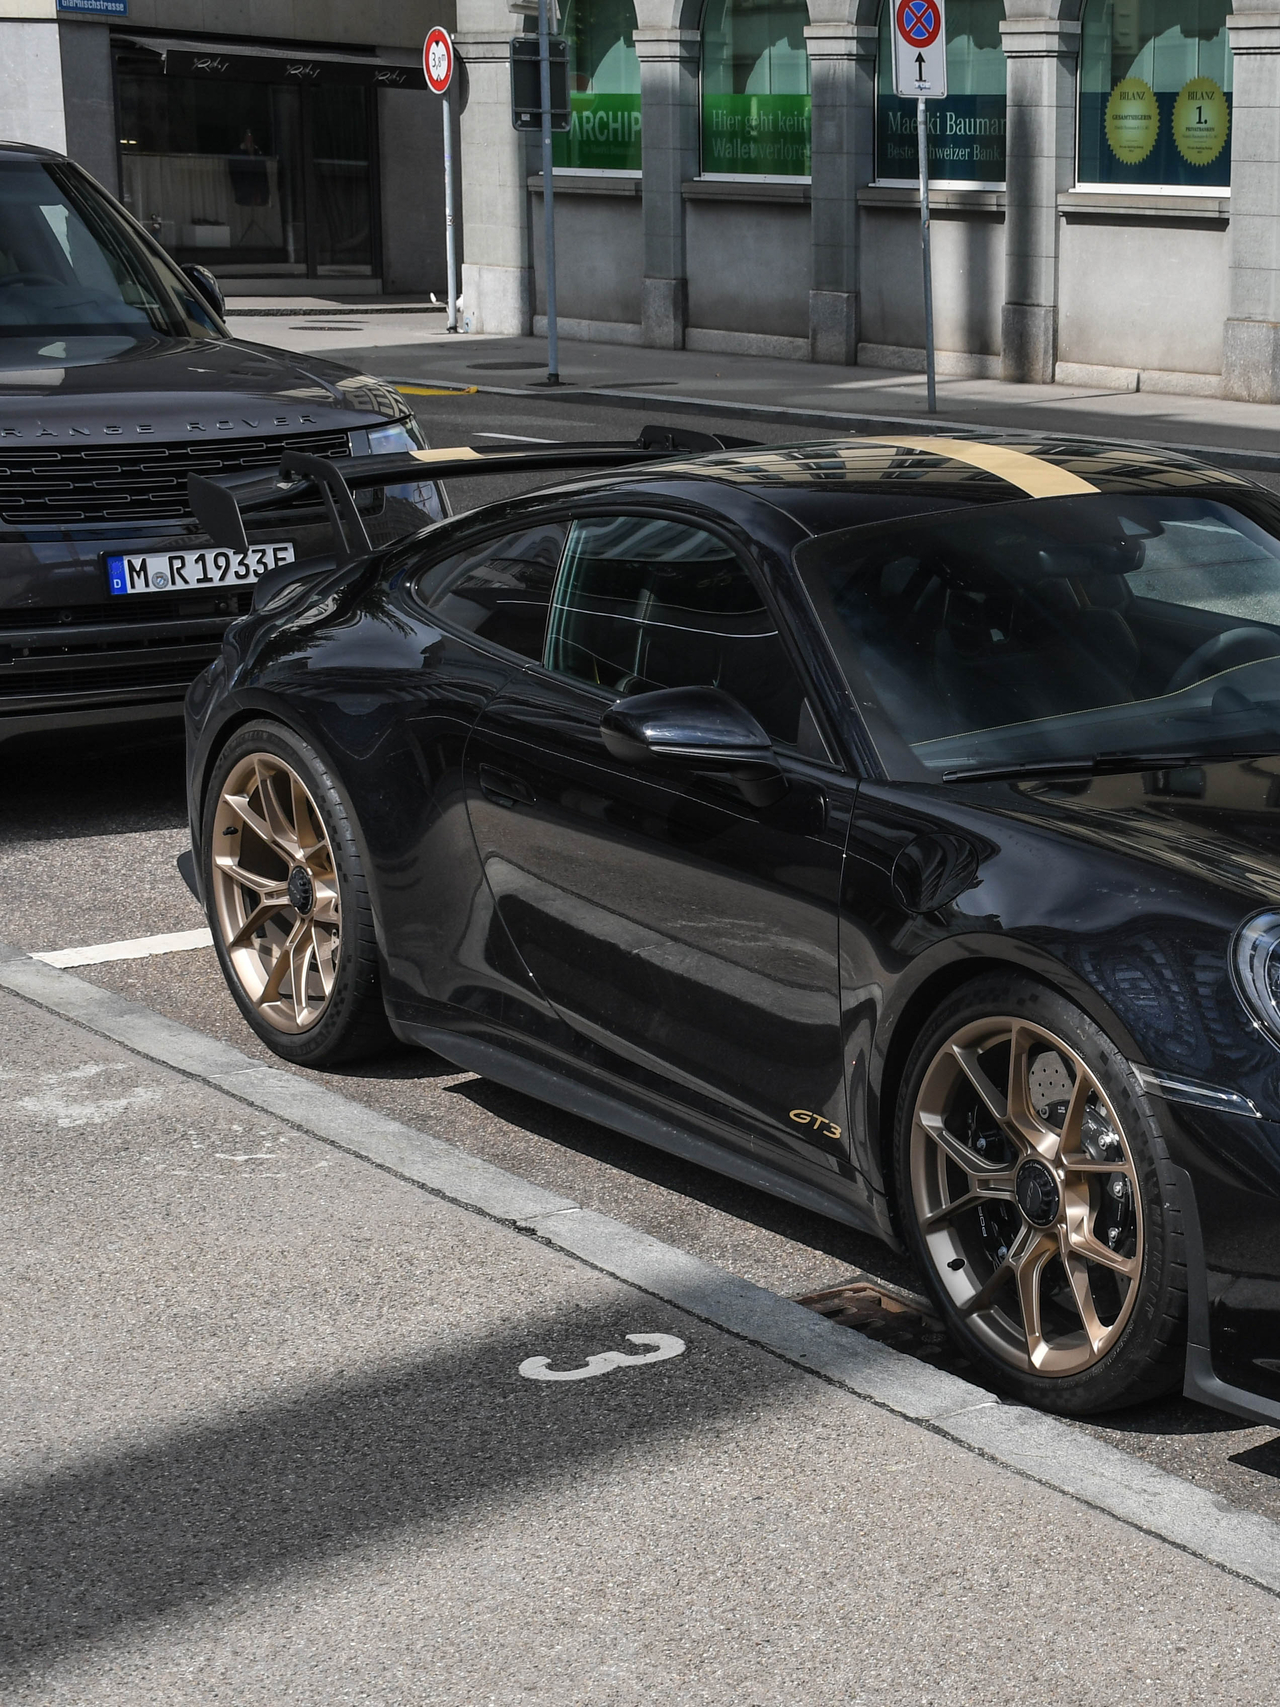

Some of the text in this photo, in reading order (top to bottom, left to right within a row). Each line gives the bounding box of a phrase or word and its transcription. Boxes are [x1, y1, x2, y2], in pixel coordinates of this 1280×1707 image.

[1120, 91, 1146, 101] BILANZ
[1187, 91, 1215, 101] BILANZ
[712, 110, 807, 136] Hier geht kein
[887, 111, 941, 135] Maeki
[1195, 105, 1208, 125] 1.
[712, 138, 757, 159] Wallet
[887, 143, 914, 159] Beste
[920, 144, 970, 160] hweizer
[0, 414, 317, 438] RANGE ROVER
[113, 579, 122, 589] D
[126, 557, 150, 590] M
[788, 1109, 842, 1139] GT3
[518, 1333, 687, 1381] 3
